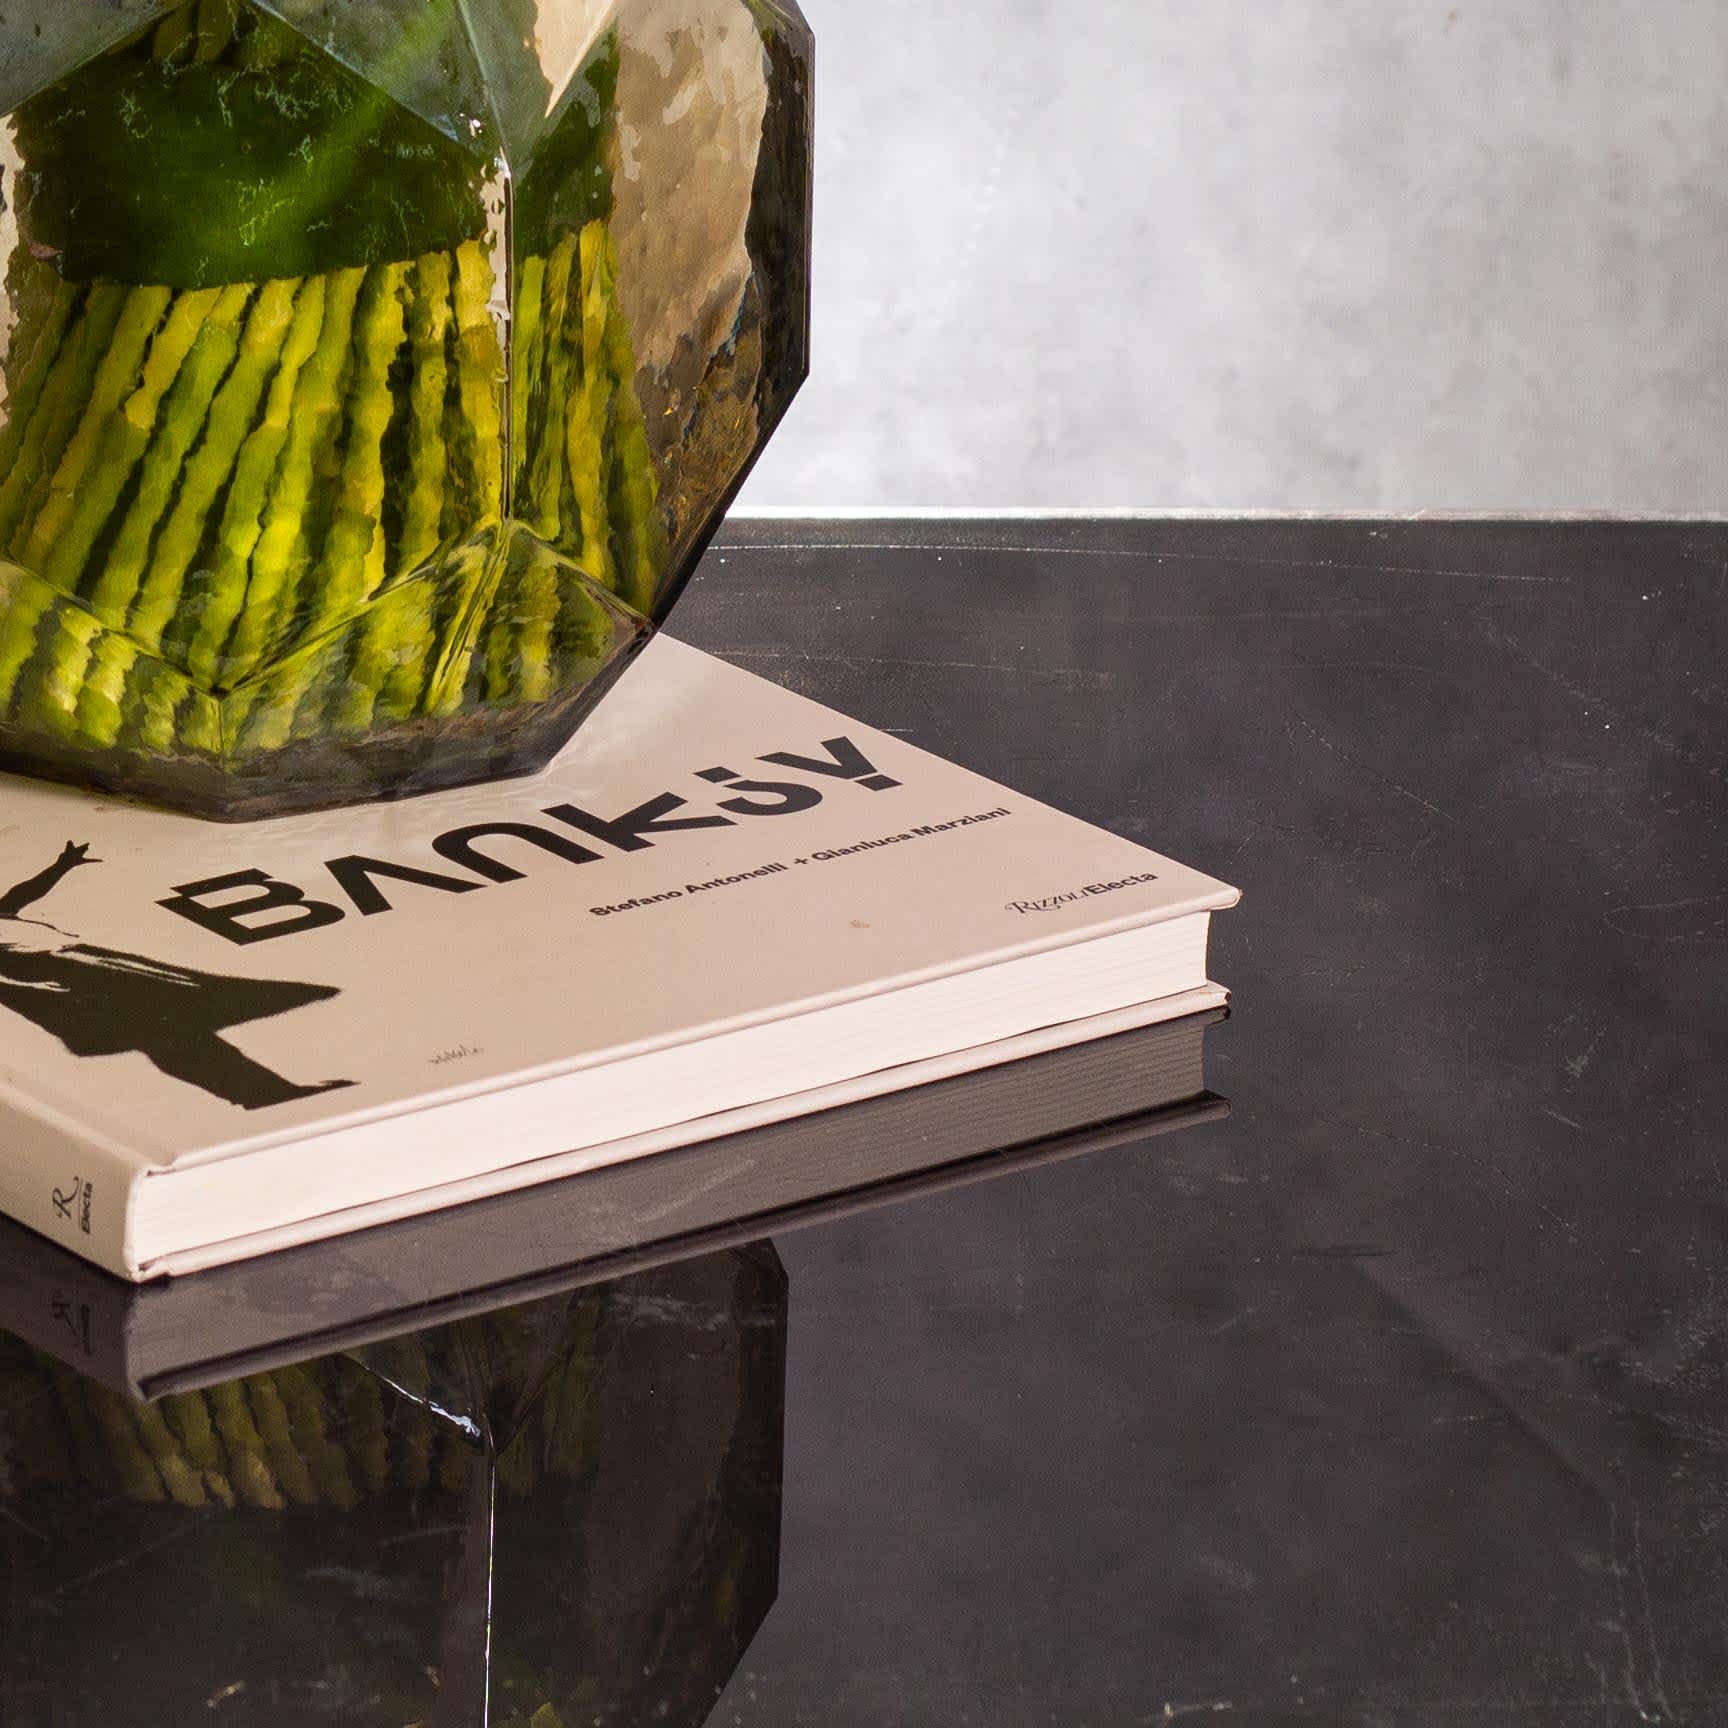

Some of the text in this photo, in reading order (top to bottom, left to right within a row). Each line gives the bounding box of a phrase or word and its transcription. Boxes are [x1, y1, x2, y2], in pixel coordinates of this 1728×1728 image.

[589, 888, 683, 917] Stefano
[685, 862, 789, 895] Antonelli
[812, 833, 913, 863] Gianluca
[910, 807, 1012, 839] Marziani
